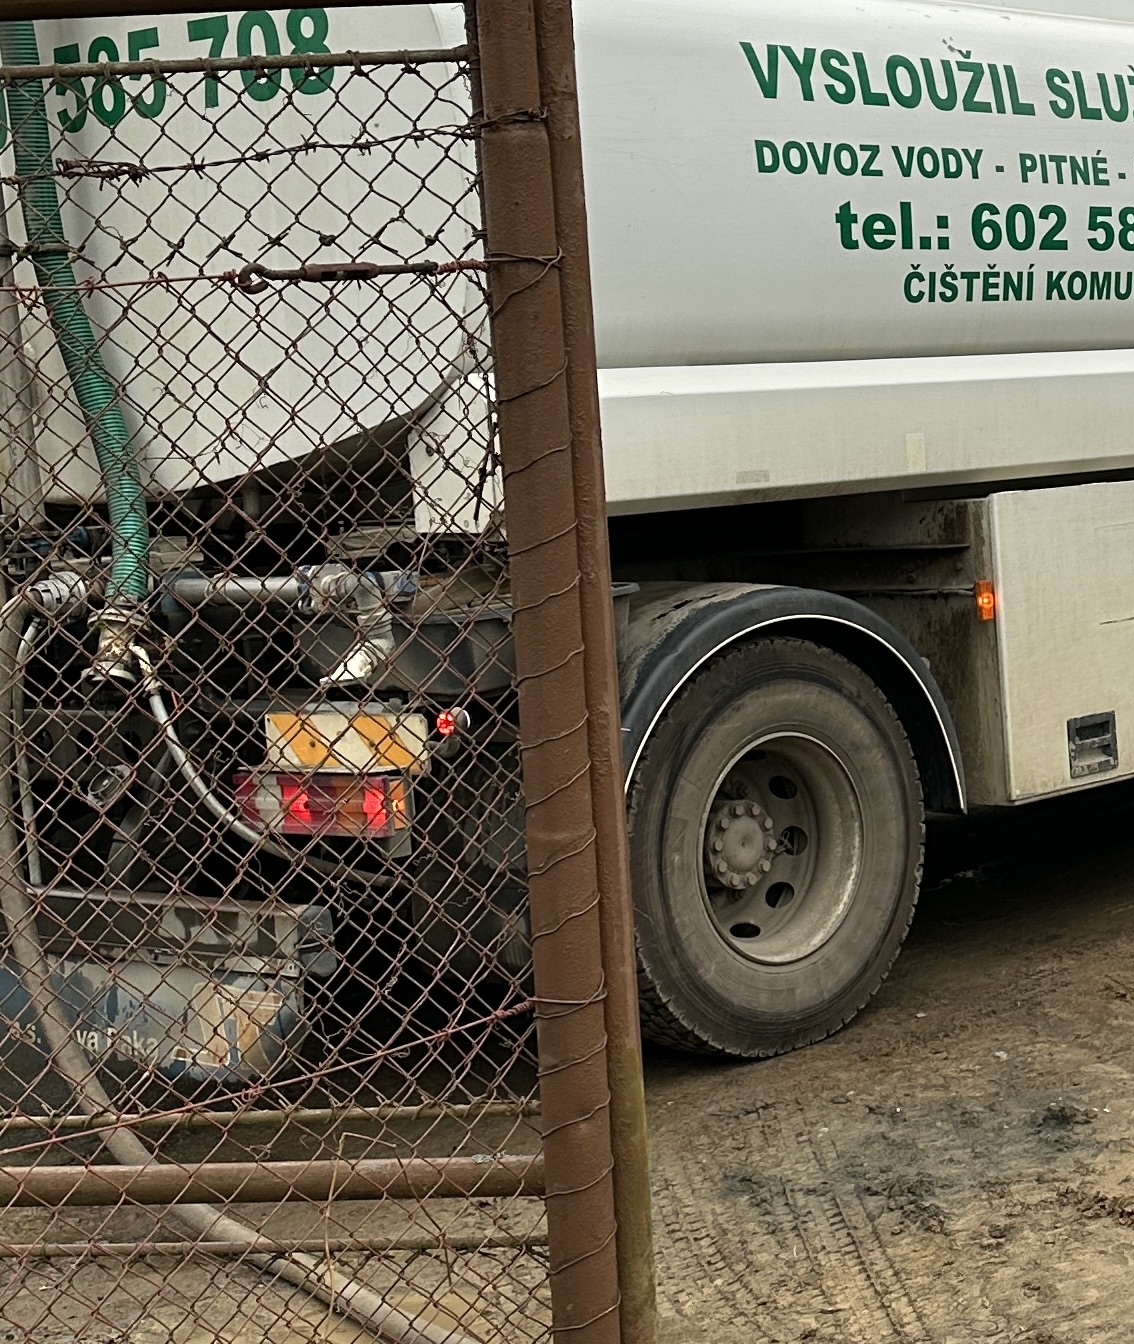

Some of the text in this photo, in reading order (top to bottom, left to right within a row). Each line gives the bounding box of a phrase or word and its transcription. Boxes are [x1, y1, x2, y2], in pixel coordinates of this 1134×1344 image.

[187, 7, 336, 110] 708
[739, 41, 1036, 116] VYSLOUŽIL
[753, 138, 884, 177] DOVOZ
[891, 144, 984, 180] VODY
[1018, 149, 1111, 187] PITNÉ
[834, 200, 951, 251] tel.:
[970, 202, 1070, 252] 602
[902, 263, 1035, 304] ČIŠTĚNÍ
